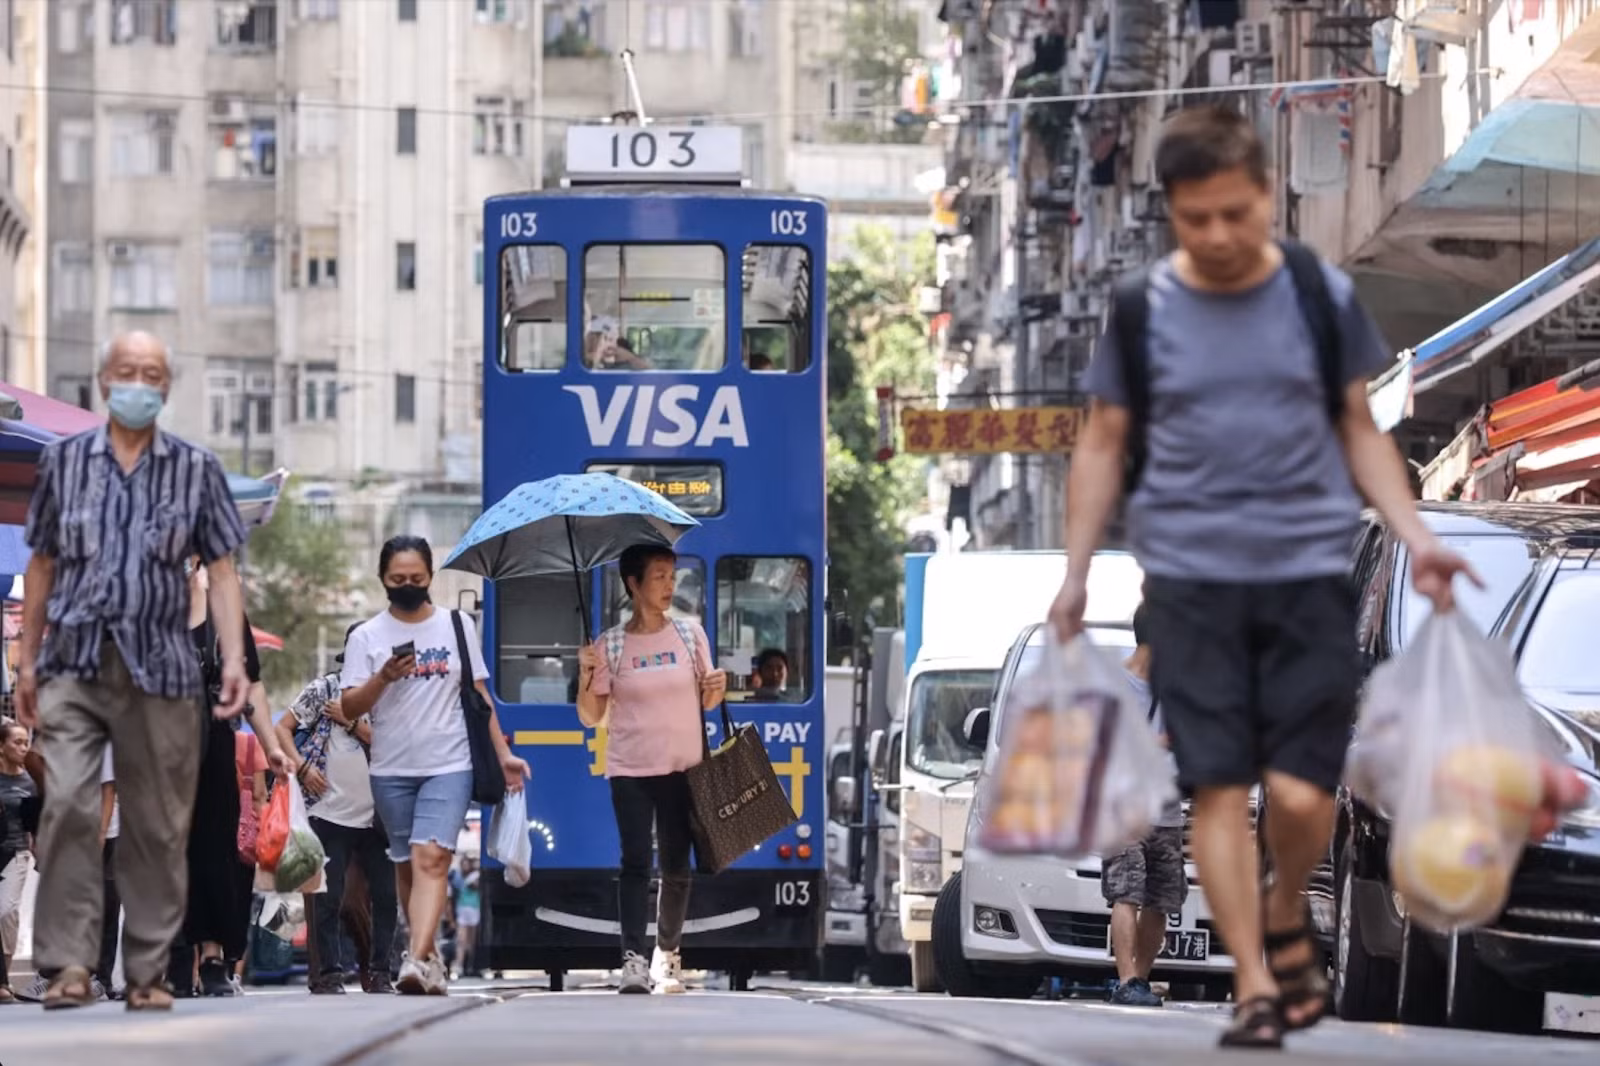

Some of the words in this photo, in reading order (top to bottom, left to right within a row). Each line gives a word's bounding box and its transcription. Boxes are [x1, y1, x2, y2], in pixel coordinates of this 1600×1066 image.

[611, 131, 696, 168] 103
[500, 212, 538, 238] 103
[771, 210, 808, 236] 103
[561, 384, 750, 448] VISA
[764, 721, 812, 744] PAY
[718, 785, 759, 819] CENURY
[775, 880, 811, 906] 103
